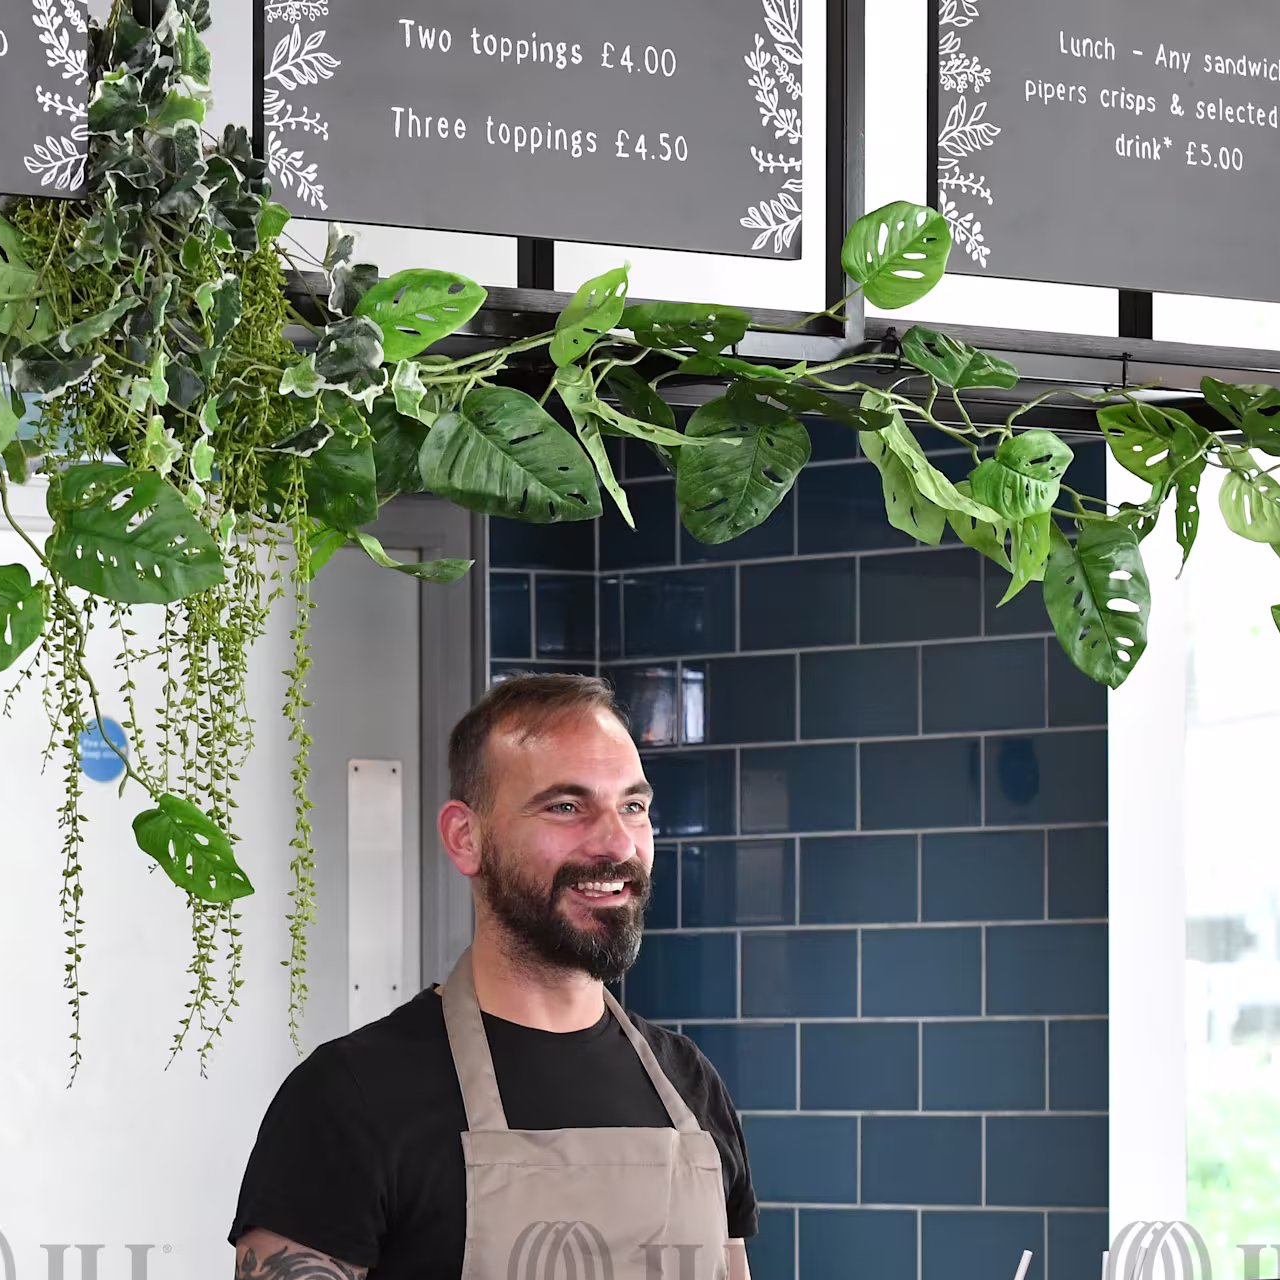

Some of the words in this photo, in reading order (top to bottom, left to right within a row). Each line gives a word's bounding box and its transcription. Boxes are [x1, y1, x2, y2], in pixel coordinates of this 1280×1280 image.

[398, 18, 453, 54] Two
[470, 27, 584, 70] toppings
[600, 41, 677, 77] £4.00
[1059, 30, 1117, 61] Lunch
[1154, 43, 1192, 74] Any
[1025, 78, 1088, 106] pipers
[1099, 87, 1157, 116] crisps
[1169, 93, 1186, 118] &
[1195, 98, 1279, 130] selected
[390, 106, 468, 140] Three
[486, 115, 598, 158] toppings
[614, 129, 689, 162] £4.50
[1185, 141, 1244, 171] £5.00
